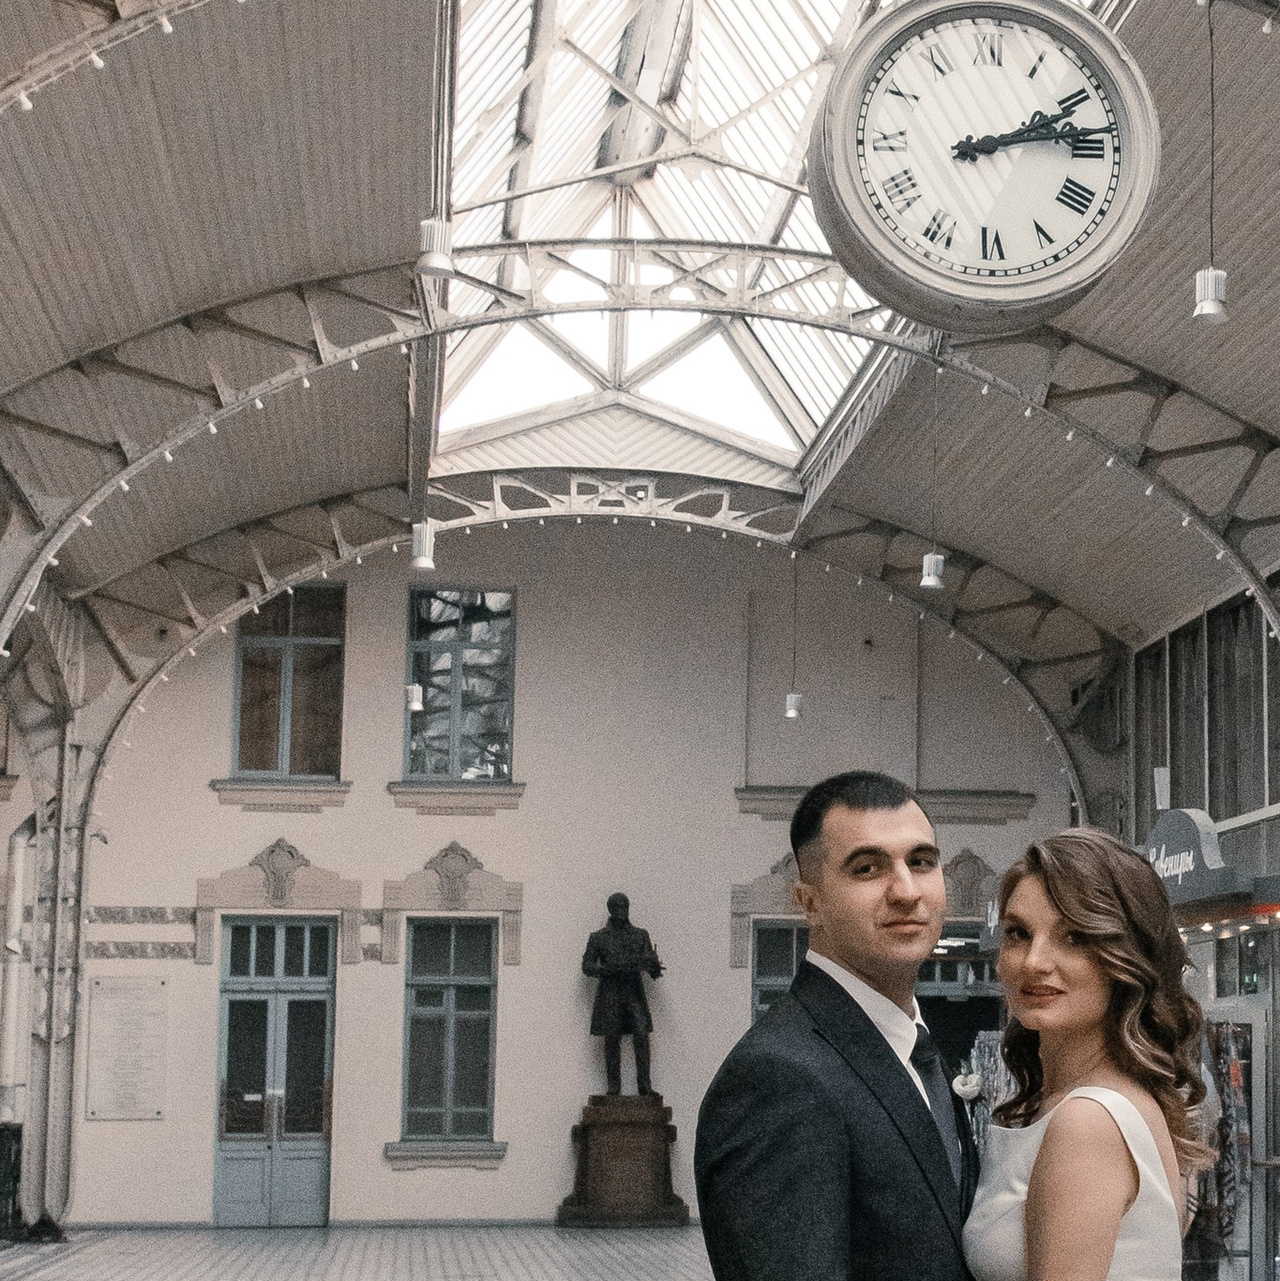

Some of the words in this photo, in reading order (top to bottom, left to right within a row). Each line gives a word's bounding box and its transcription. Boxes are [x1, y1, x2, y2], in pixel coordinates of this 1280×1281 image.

[919, 42, 955, 81] XI
[971, 33, 1003, 67] XII
[1026, 50, 1047, 80] I
[883, 77, 920, 113] X
[1055, 87, 1092, 114] II
[1071, 138, 1105, 161] III
[881, 166, 922, 217] VIII
[1053, 174, 1096, 217] IIII
[922, 207, 957, 251] VII
[979, 226, 1007, 261] VI
[1032, 219, 1056, 249] V
